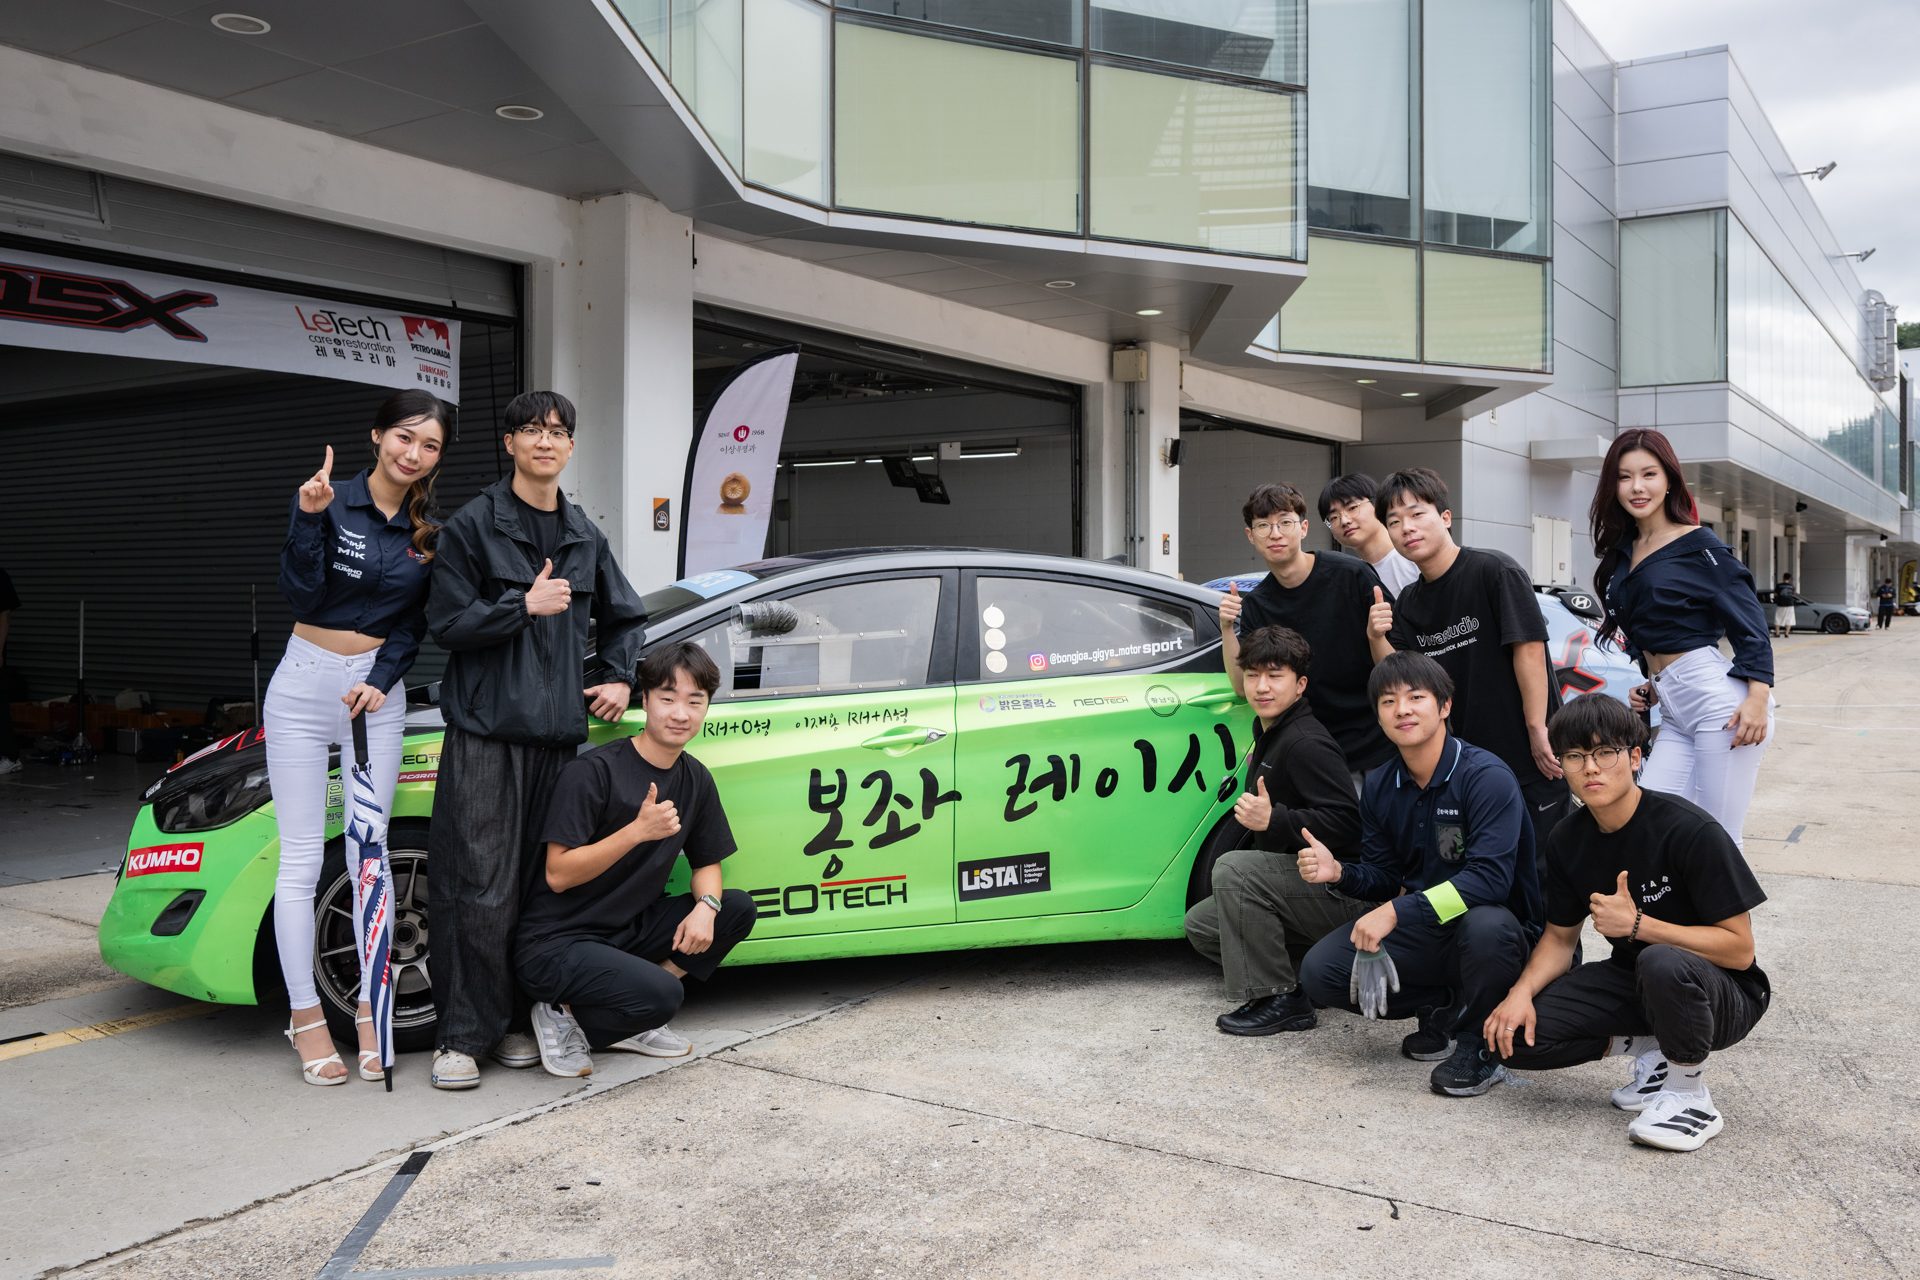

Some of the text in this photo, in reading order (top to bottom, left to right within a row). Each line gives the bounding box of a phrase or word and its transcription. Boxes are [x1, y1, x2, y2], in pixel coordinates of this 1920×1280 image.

[294, 305, 391, 342] LeTech
[342, 339, 395, 354] restoration
[419, 363, 449, 379] LUBRICANTS
[337, 546, 366, 560] MIK
[333, 563, 362, 576] KUMHO
[803, 723, 1239, 880] 봉좌 레이싱
[128, 848, 200, 872] KUMHO
[747, 882, 908, 920] EOTECH
[1643, 885, 1672, 903] STUDIO
